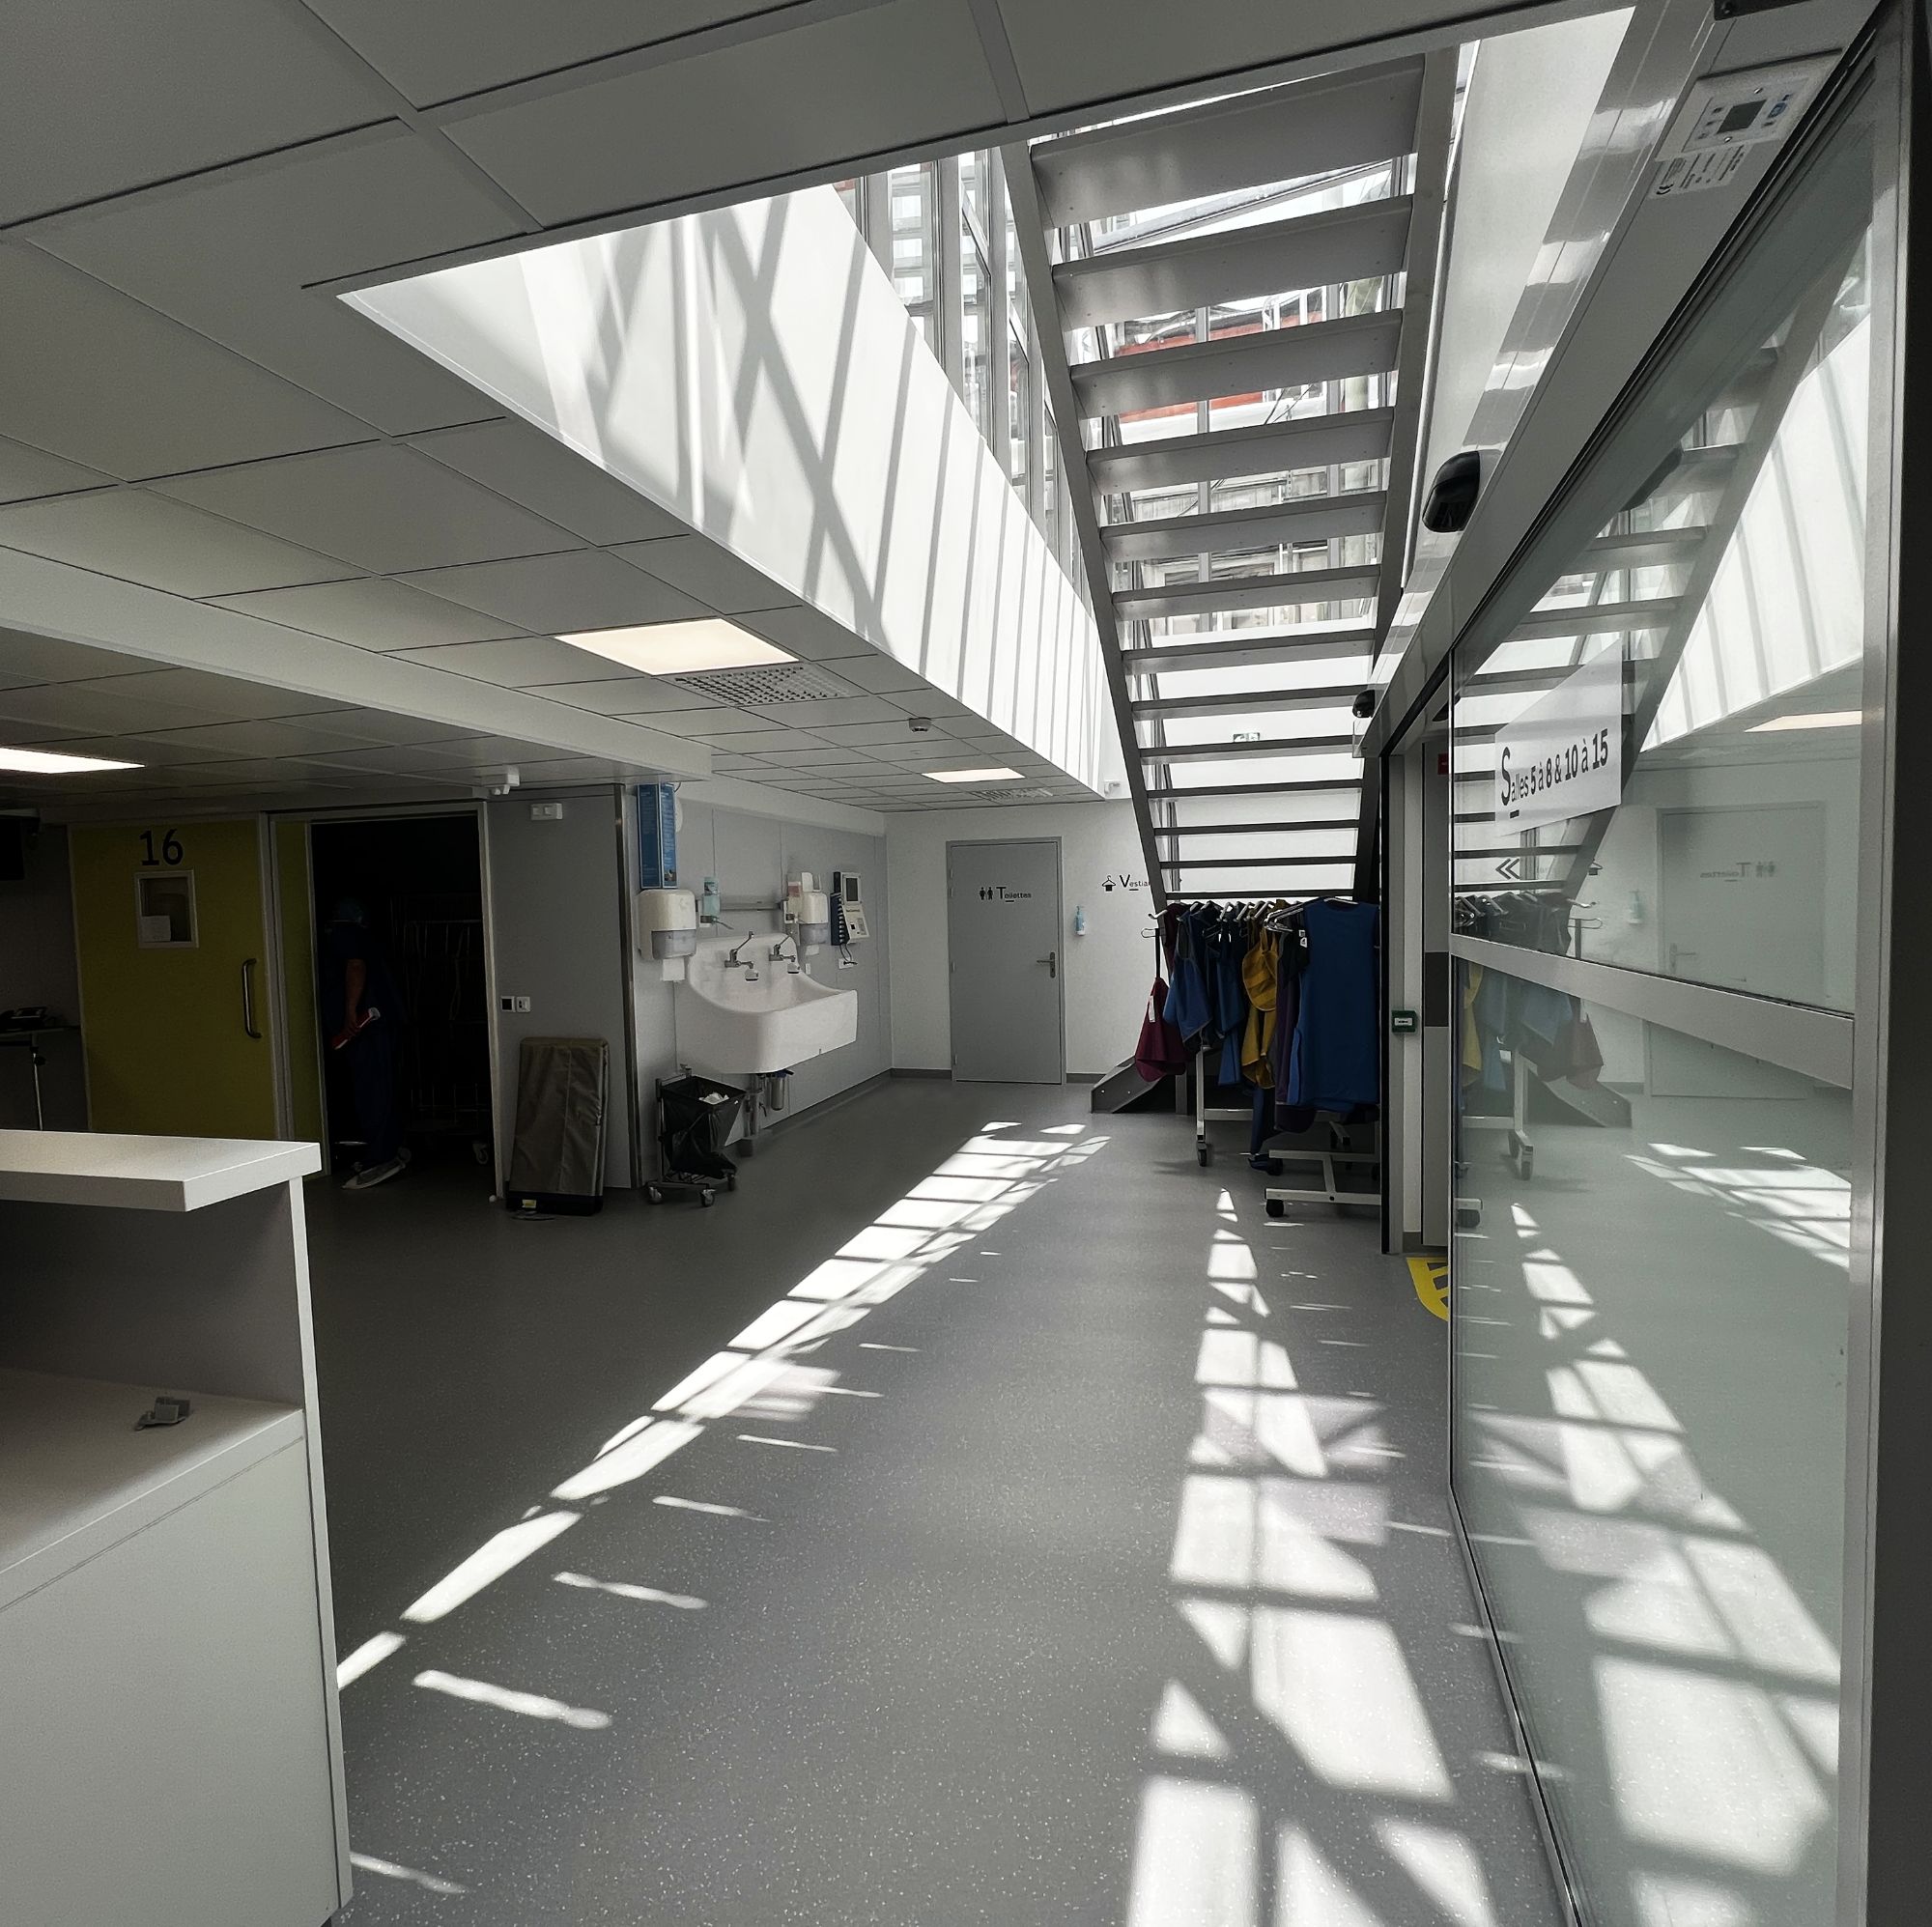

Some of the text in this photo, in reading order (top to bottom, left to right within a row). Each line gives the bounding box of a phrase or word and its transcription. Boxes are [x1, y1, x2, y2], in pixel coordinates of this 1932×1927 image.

[1501, 727, 1608, 806] Salles 5 à 8 & 10 à 15
[139, 829, 184, 865] 16
[1119, 874, 1151, 888] Vestia
